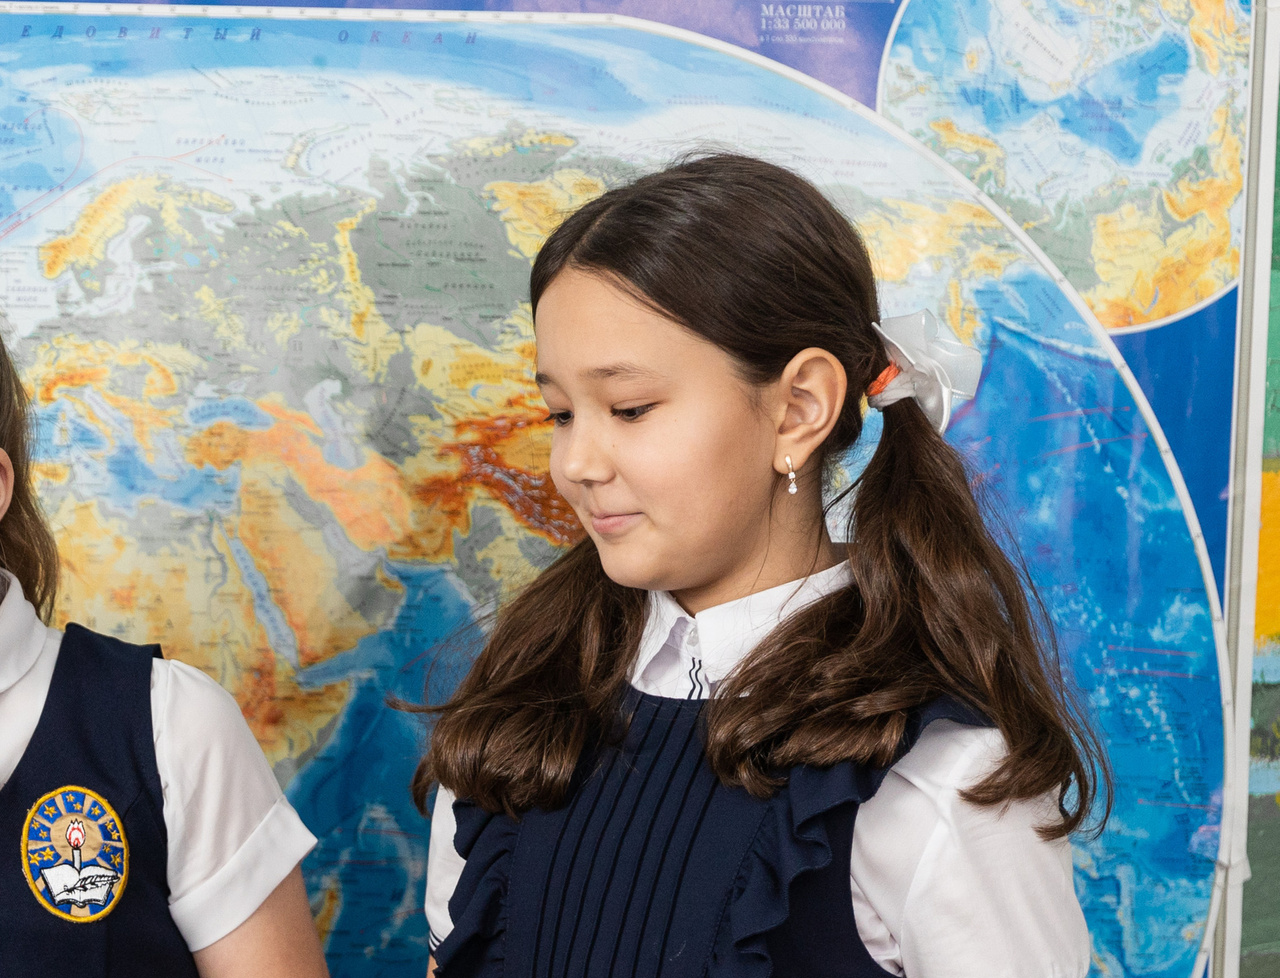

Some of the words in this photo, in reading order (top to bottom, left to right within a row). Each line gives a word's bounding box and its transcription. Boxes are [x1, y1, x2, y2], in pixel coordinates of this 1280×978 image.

[760, 4, 846, 18] МАСШТАБ
[760, 18, 789, 30] 1:33
[793, 18, 818, 30] 500
[821, 18, 846, 31] 000
[337, 29, 478, 45] ОКЕАН
